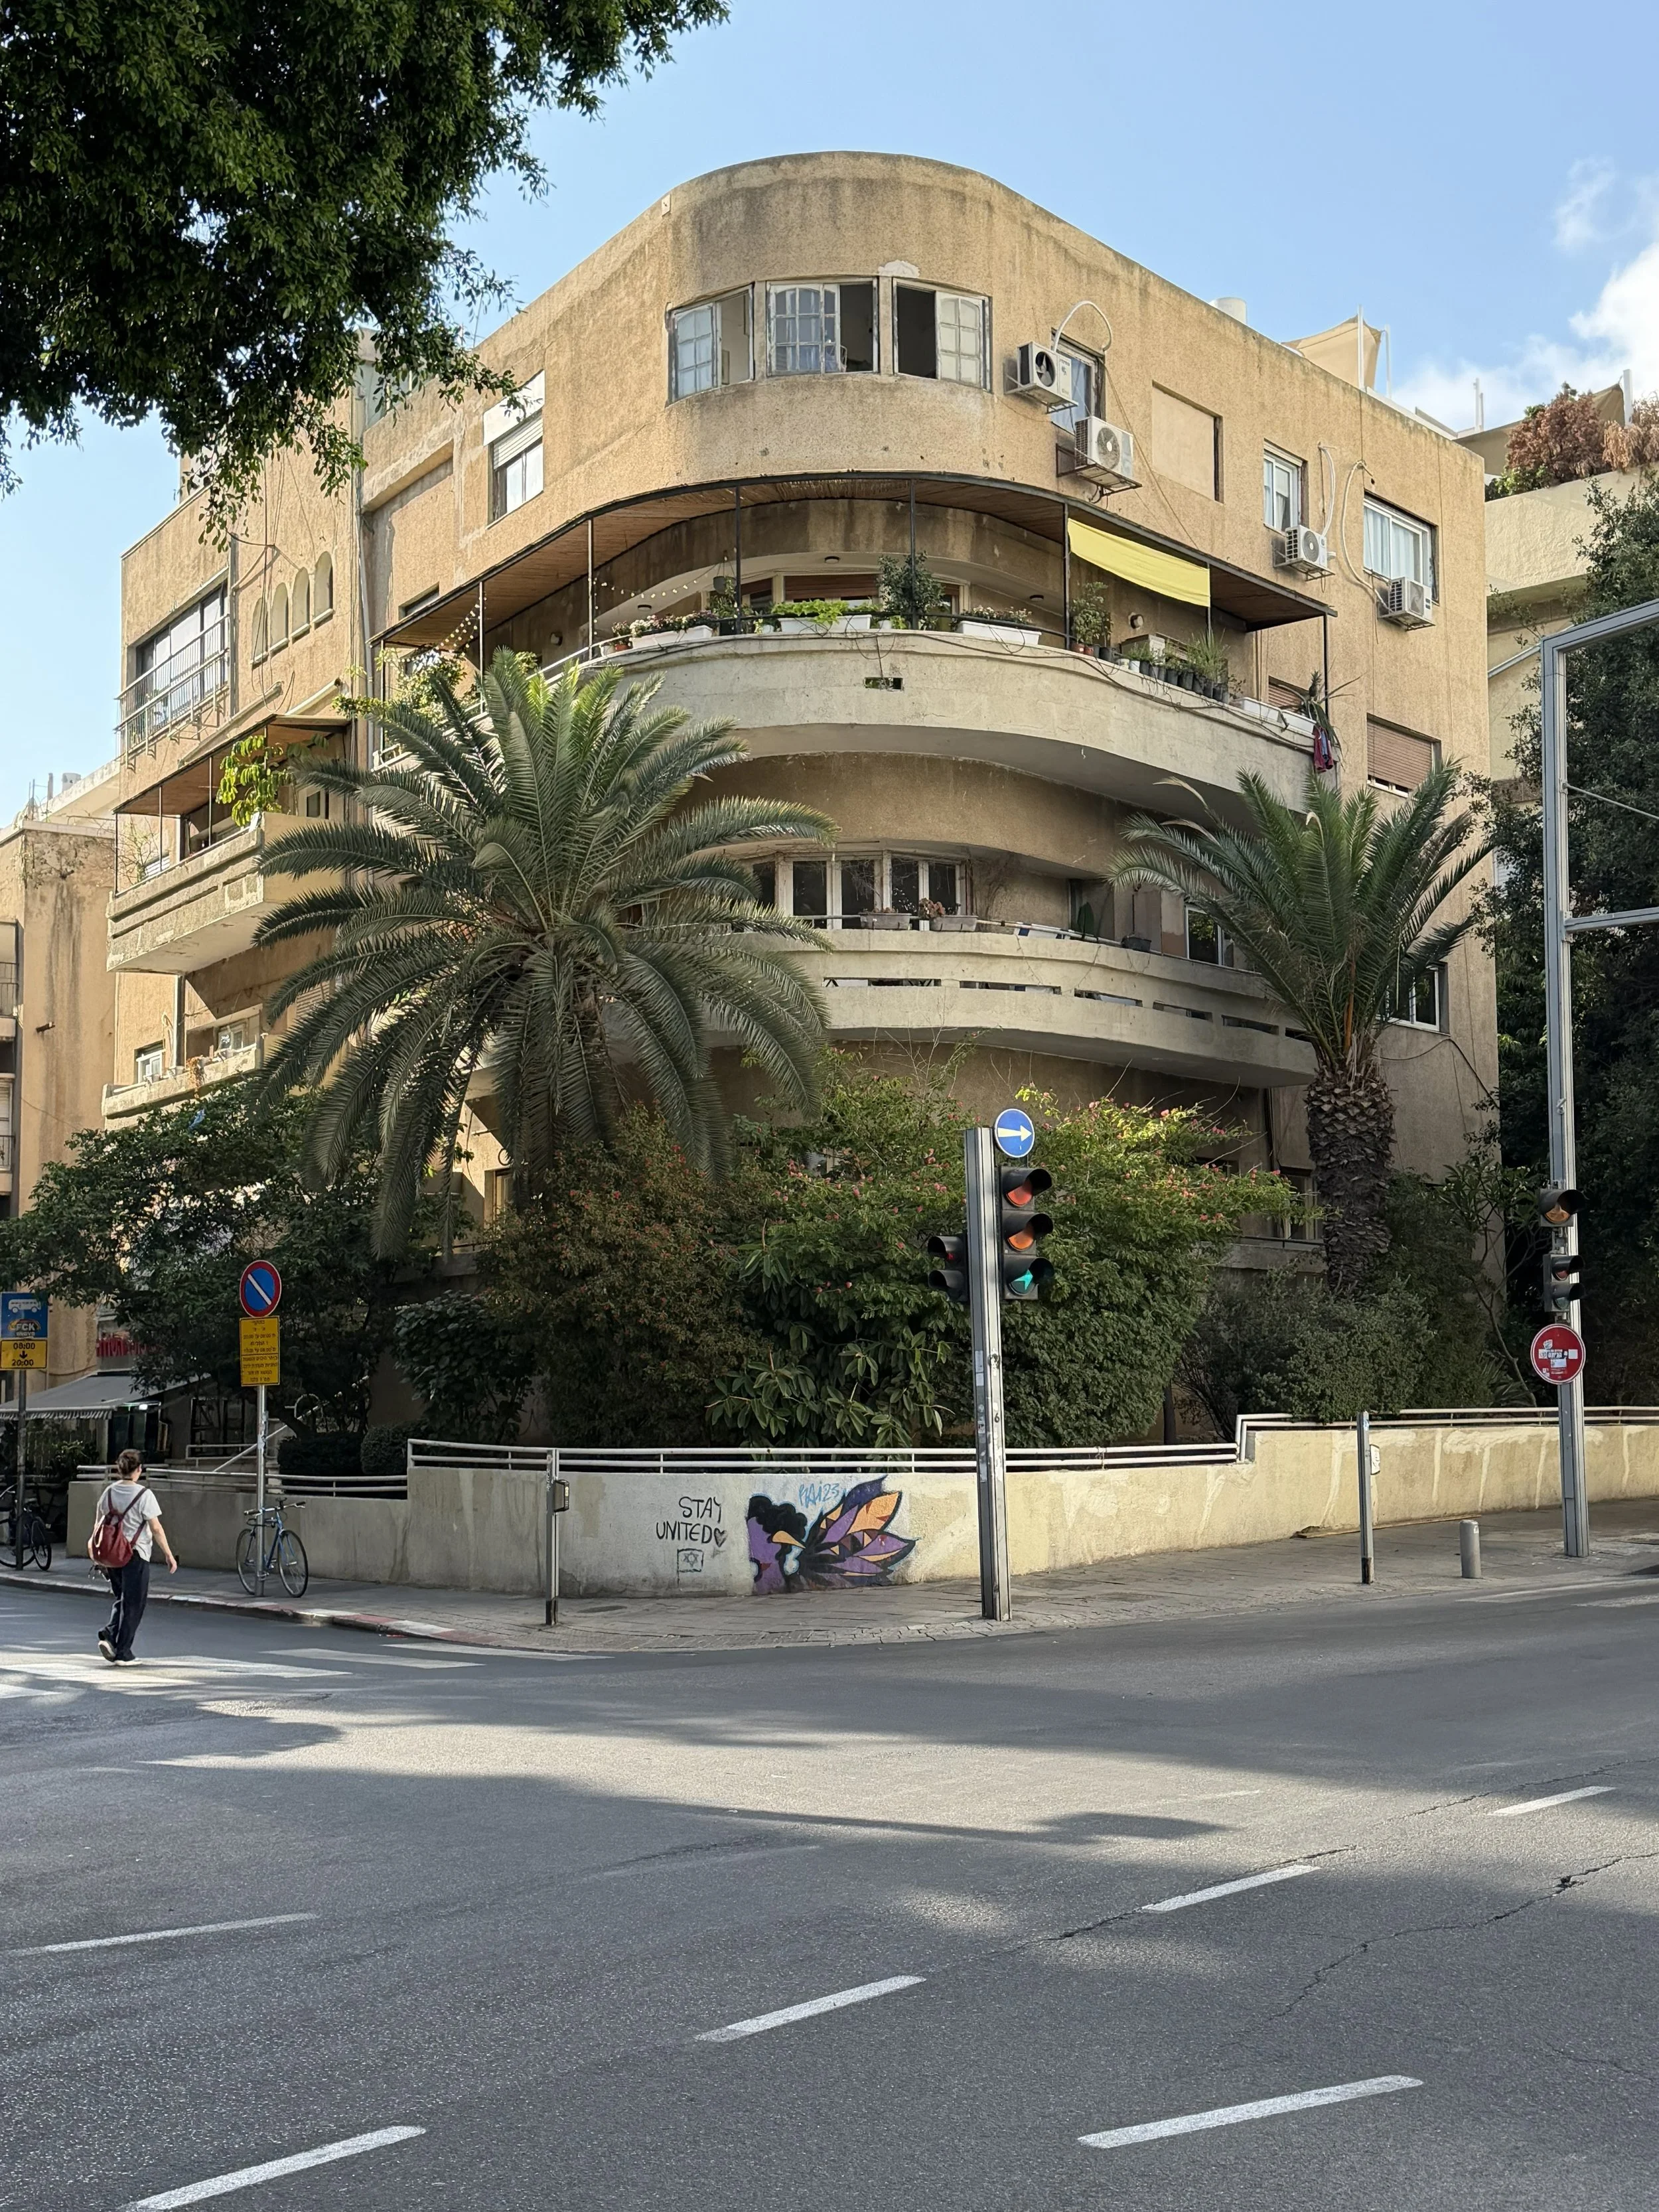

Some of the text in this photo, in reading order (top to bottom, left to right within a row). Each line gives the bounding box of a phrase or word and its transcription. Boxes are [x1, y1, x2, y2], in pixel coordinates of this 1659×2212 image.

[994, 1412, 1000, 1423] 6
[678, 1496, 721, 1524] STAY
[656, 1520, 713, 1544] UNITED
